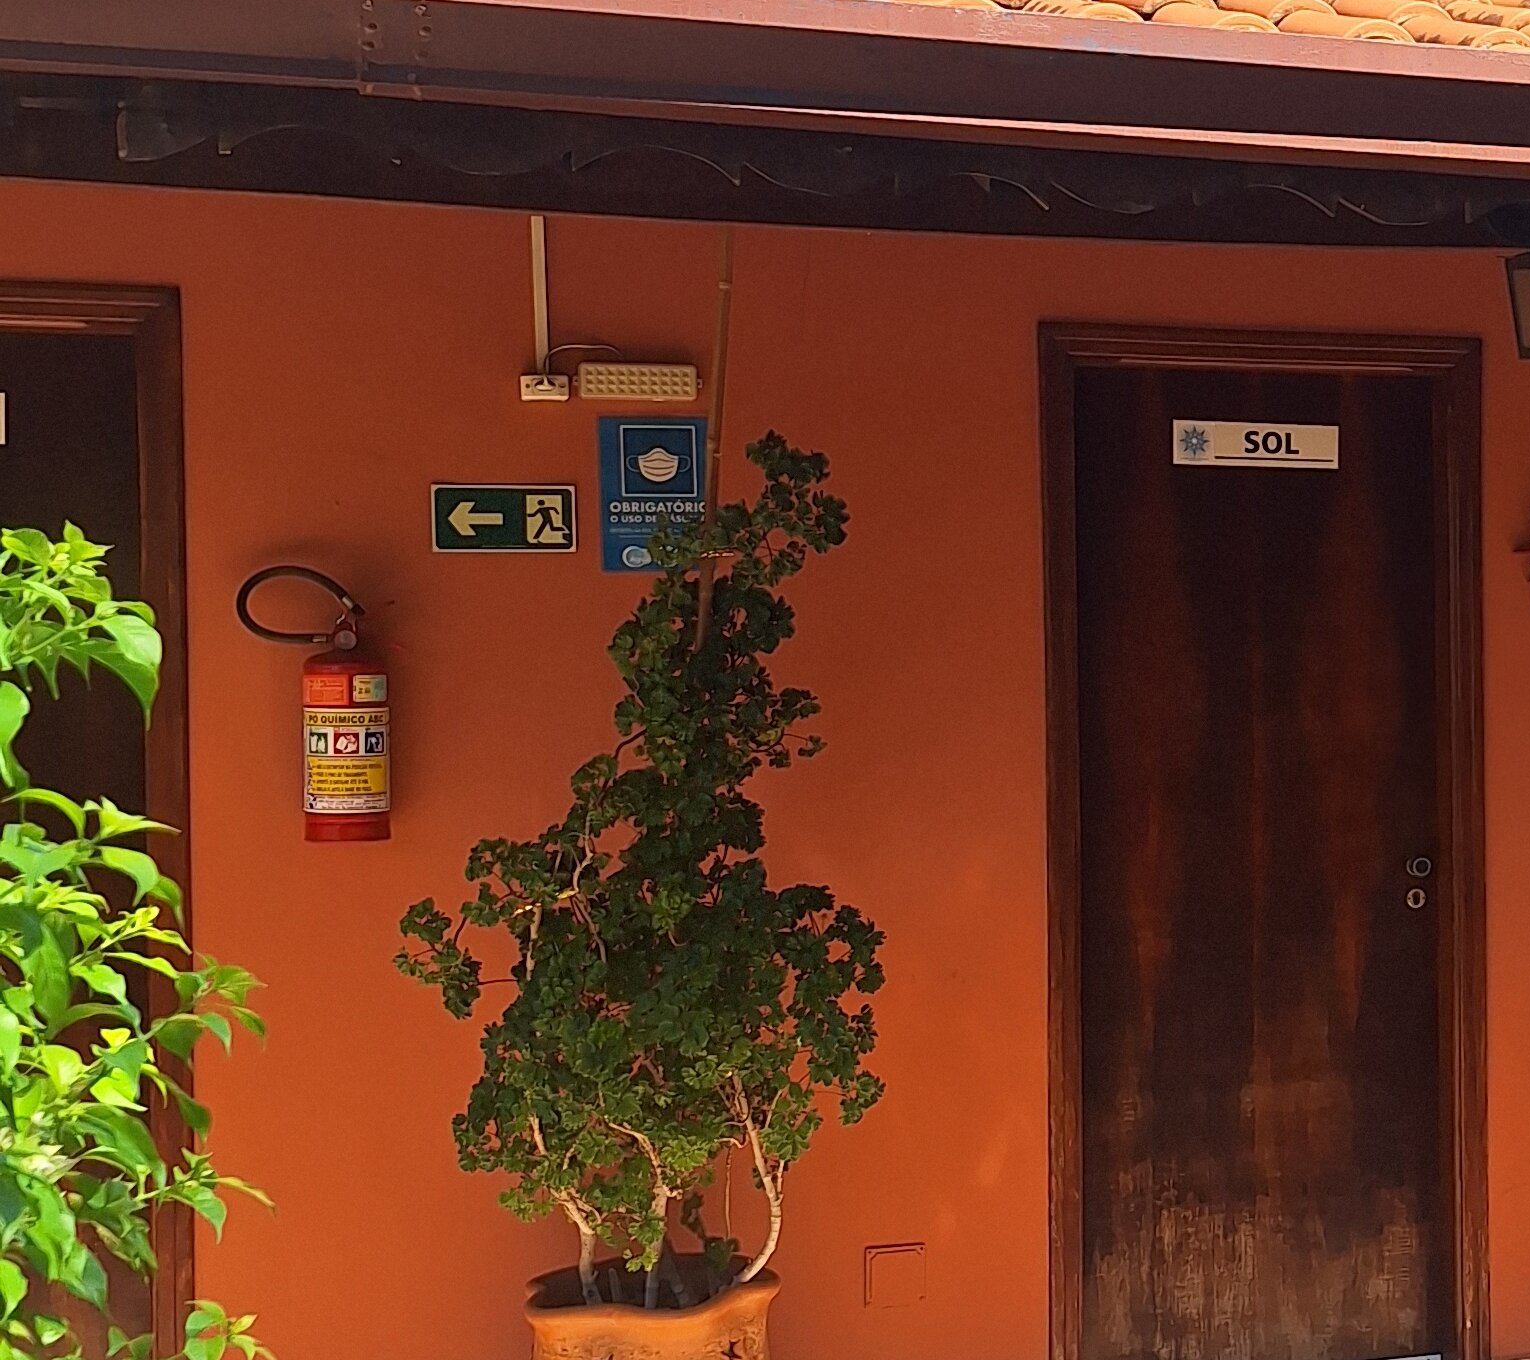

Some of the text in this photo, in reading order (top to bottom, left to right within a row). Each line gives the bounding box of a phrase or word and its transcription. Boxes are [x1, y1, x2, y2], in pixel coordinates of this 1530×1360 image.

[1244, 430, 1300, 455] SOL
[610, 515, 619, 523] O
[621, 515, 643, 523] USO
[320, 713, 365, 724] QUÍMICO
